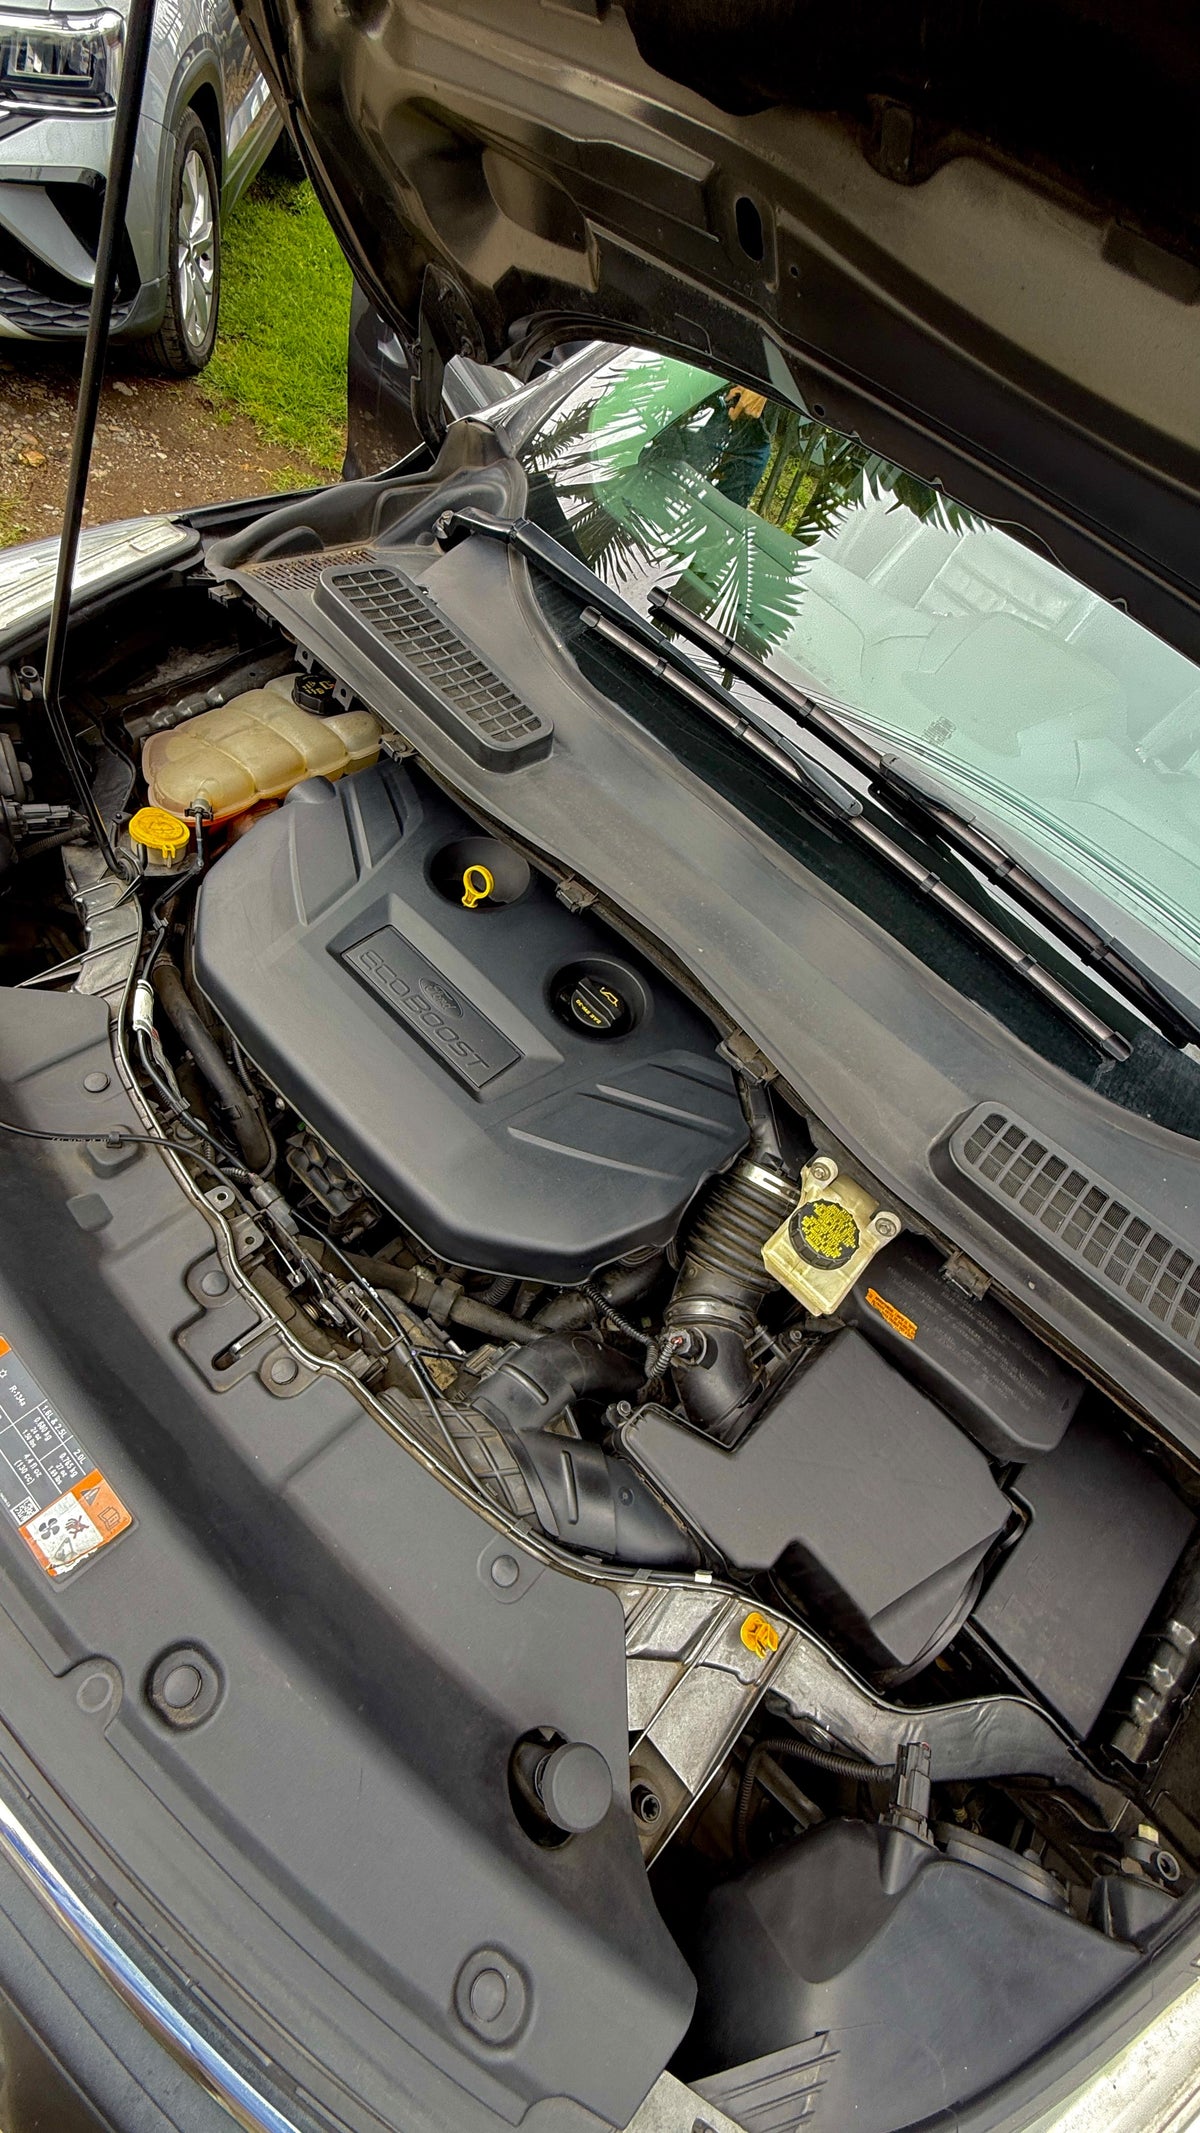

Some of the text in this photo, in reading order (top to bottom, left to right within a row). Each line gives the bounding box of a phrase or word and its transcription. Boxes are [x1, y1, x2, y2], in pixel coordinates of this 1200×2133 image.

[423, 981, 457, 1011] Ford
[589, 1013, 601, 1023] SAE
[9, 1385, 25, 1406] R-134a
[42, 1406, 53, 1419] 1.6L
[55, 1424, 67, 1438] 2.5L
[44, 1431, 52, 1441] kg
[24, 1454, 33, 1463] 4.4
[34, 1469, 42, 1477] oz
[59, 1453, 78, 1478] 0.765 kg
[73, 1449, 86, 1464] 2.0L
[14, 1460, 35, 1485] (130 cc)
